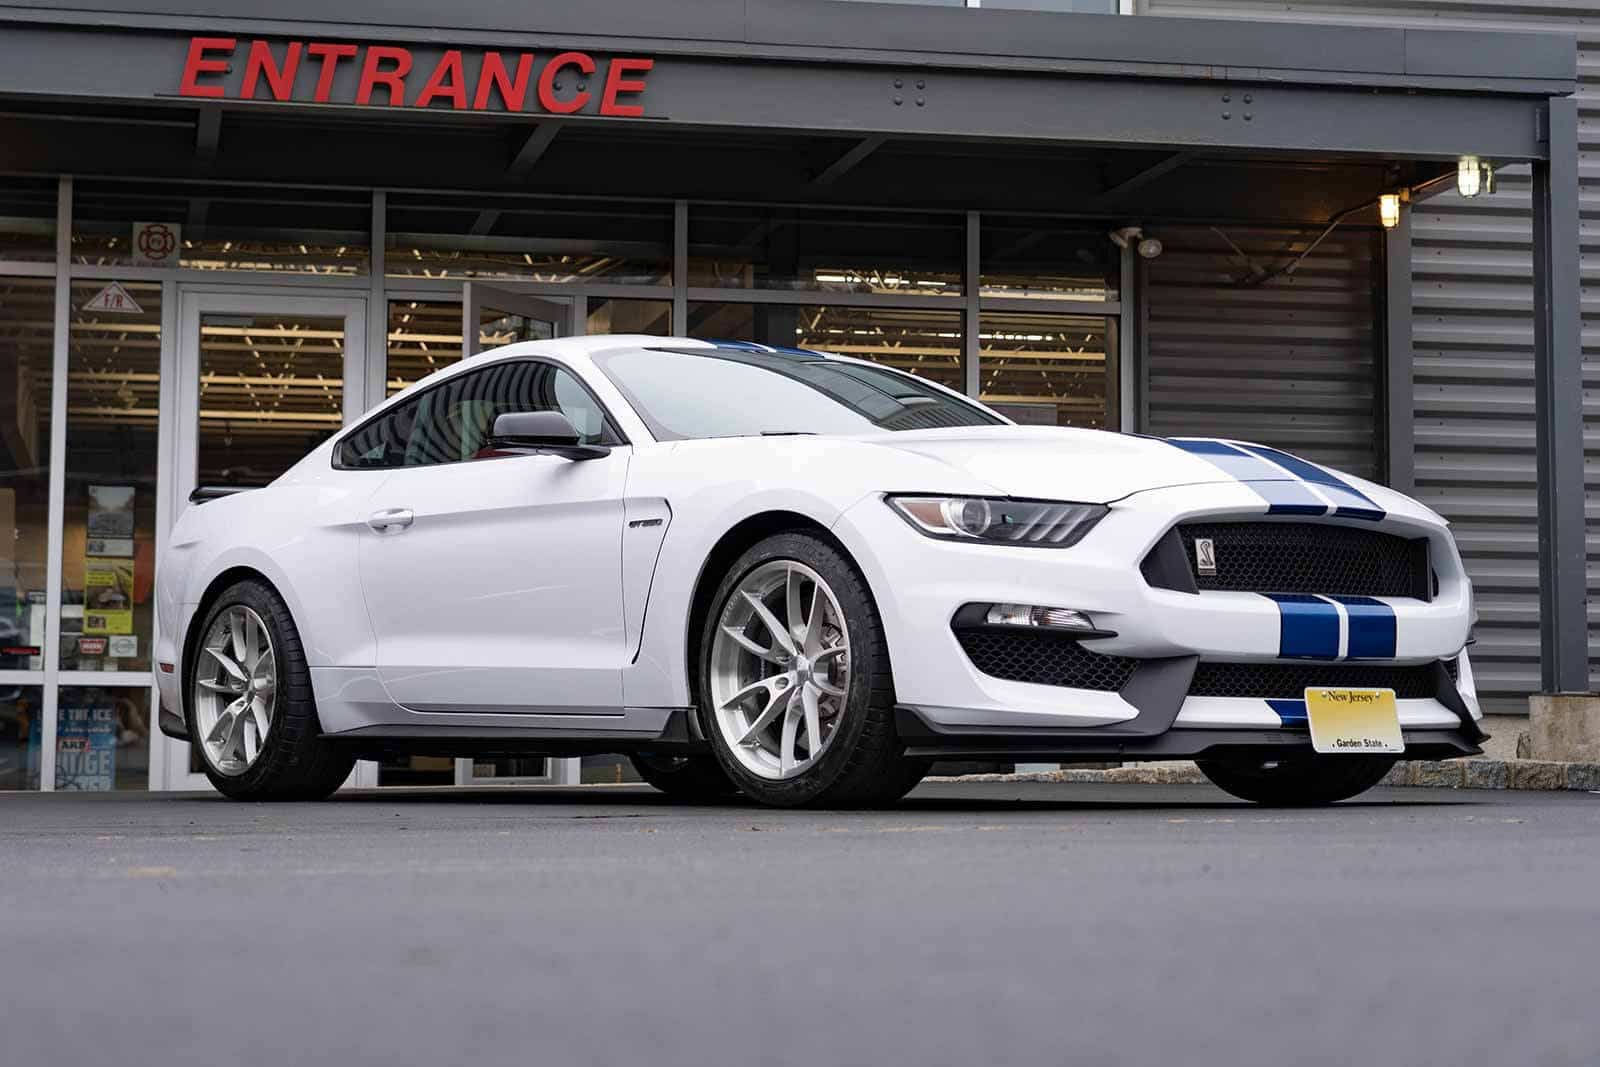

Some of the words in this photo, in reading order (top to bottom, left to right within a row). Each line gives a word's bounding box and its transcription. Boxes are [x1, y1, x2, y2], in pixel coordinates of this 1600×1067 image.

[180, 37, 655, 117] ENTRANCE
[1328, 691, 1347, 702] New
[1349, 691, 1374, 704] Jersey
[92, 708, 113, 721] ICE
[1336, 738, 1362, 748] Garden
[1363, 738, 1383, 748] State
